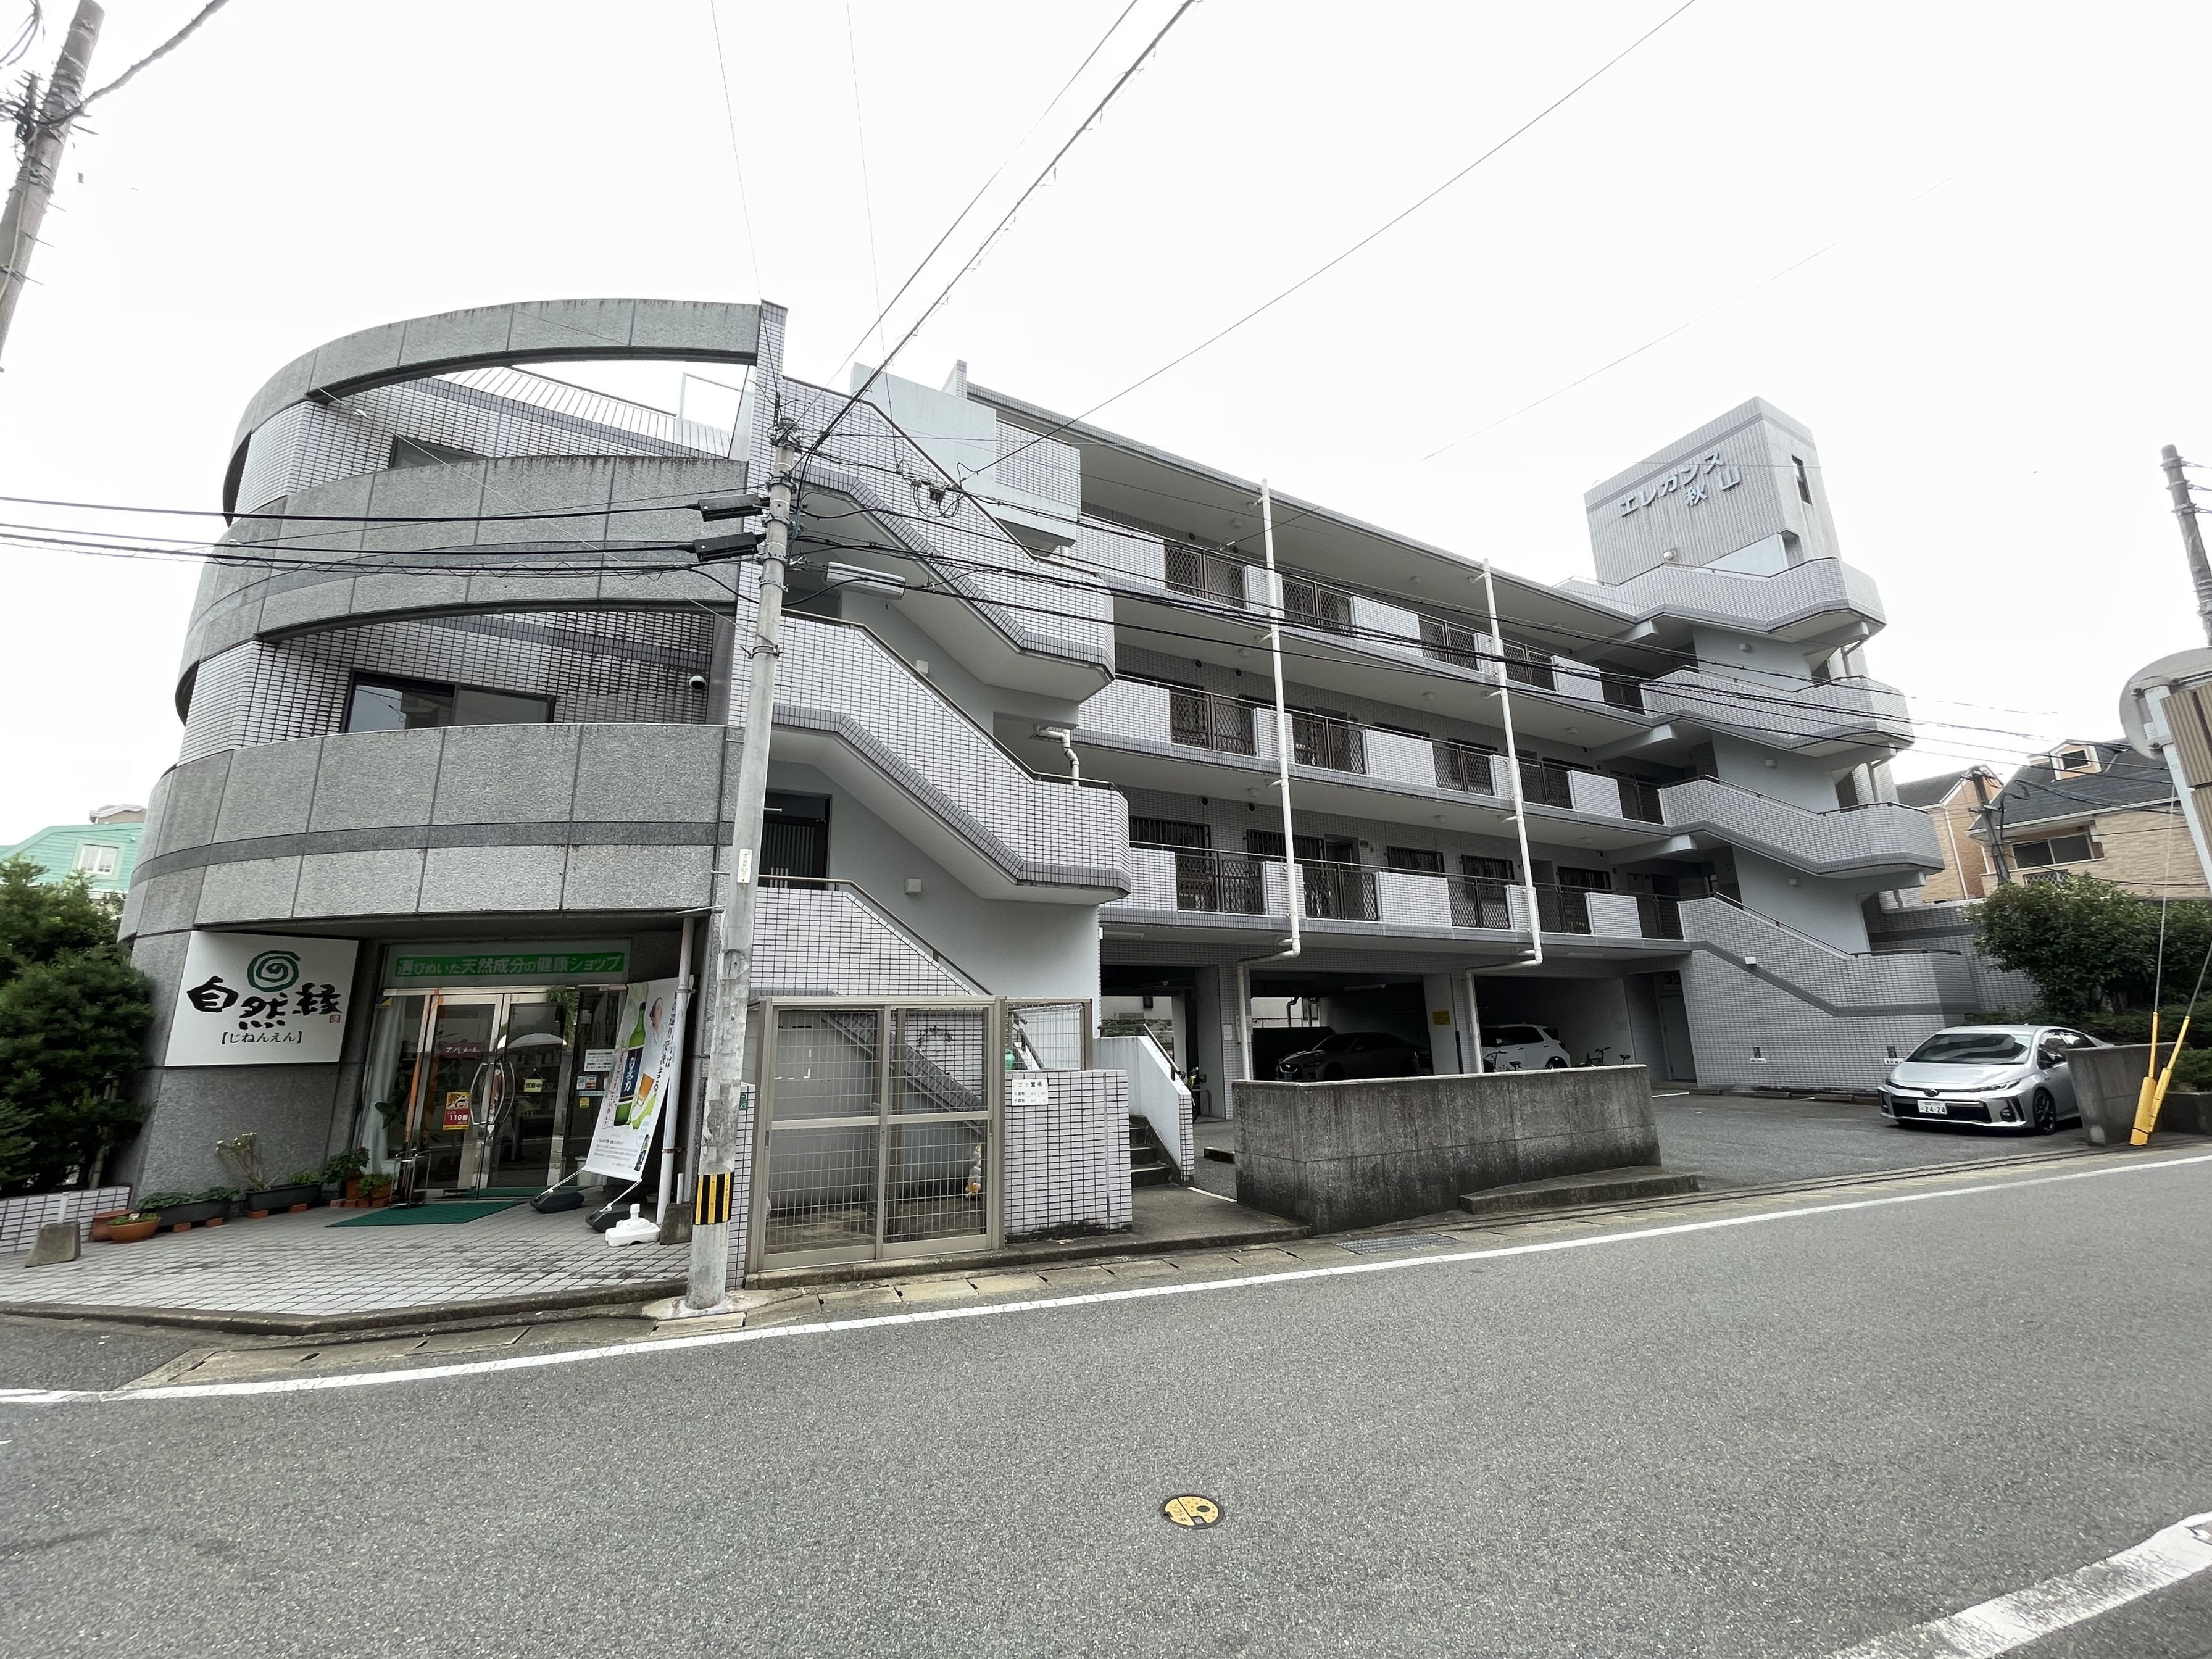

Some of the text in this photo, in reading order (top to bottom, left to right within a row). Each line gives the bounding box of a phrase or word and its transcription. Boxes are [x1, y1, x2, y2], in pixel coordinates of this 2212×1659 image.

[1620, 451, 1724, 517] エレガンス
[1686, 465, 1741, 506] 秋山
[186, 975, 343, 1030] 自然縁
